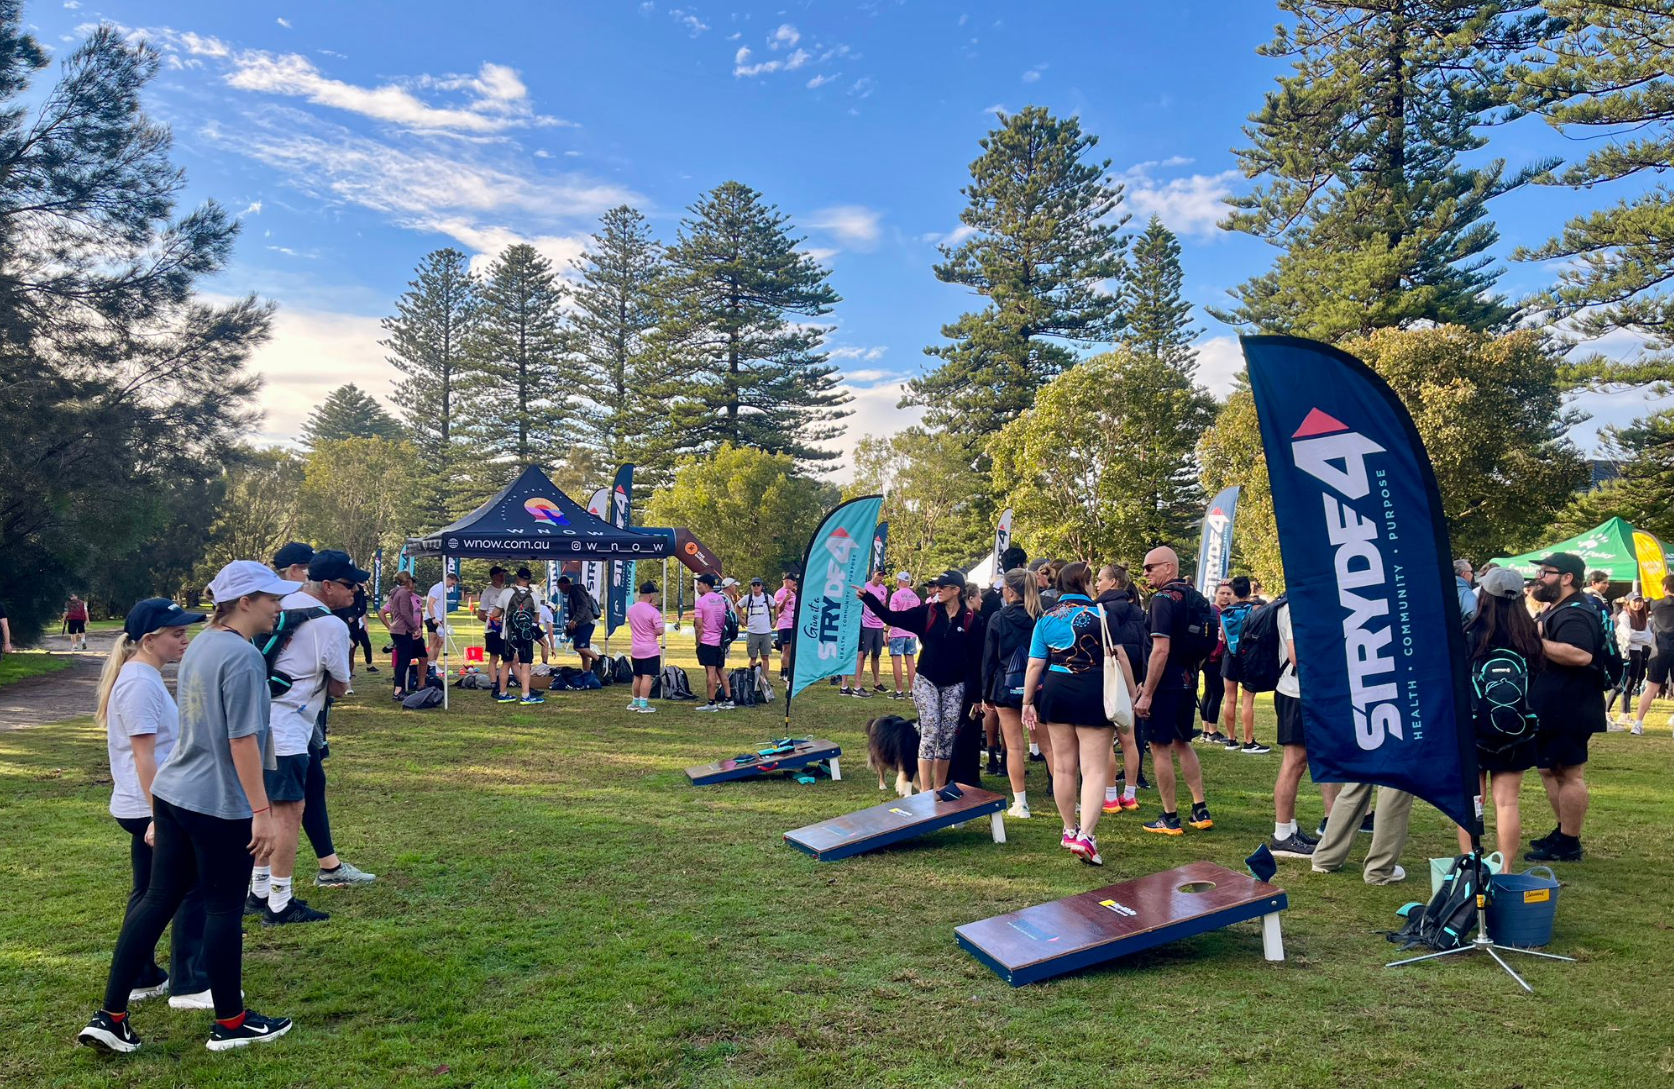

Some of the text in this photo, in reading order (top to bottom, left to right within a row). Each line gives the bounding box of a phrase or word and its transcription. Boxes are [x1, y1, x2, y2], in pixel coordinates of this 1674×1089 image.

[463, 539, 550, 550] wnow.com.au
[818, 536, 859, 660] STRYDE4
[1291, 432, 1404, 751] STRYDE4
[1375, 469, 1424, 740] HEALTH COMMUNITY PURPOSE
[803, 614, 819, 639] Give
